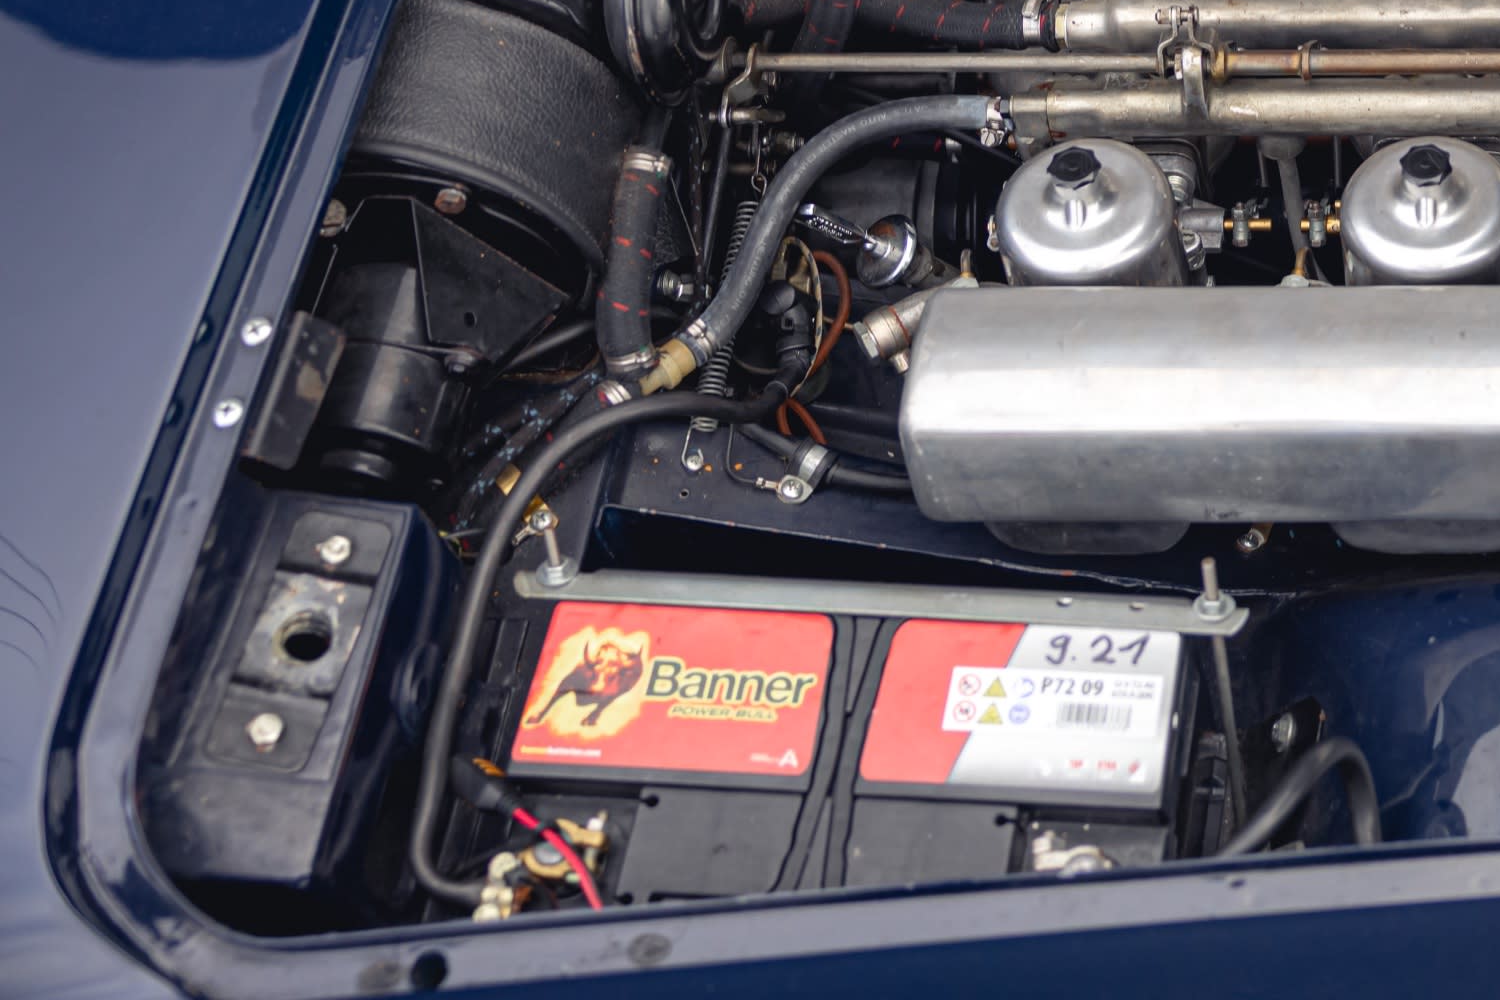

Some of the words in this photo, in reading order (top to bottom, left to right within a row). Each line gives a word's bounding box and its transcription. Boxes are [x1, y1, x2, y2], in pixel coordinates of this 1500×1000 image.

[1090, 631, 1151, 666] 21
[645, 658, 815, 705] Banner
[1040, 676, 1076, 695] P72
[1081, 679, 1105, 697] 09
[672, 705, 731, 717] POWER
